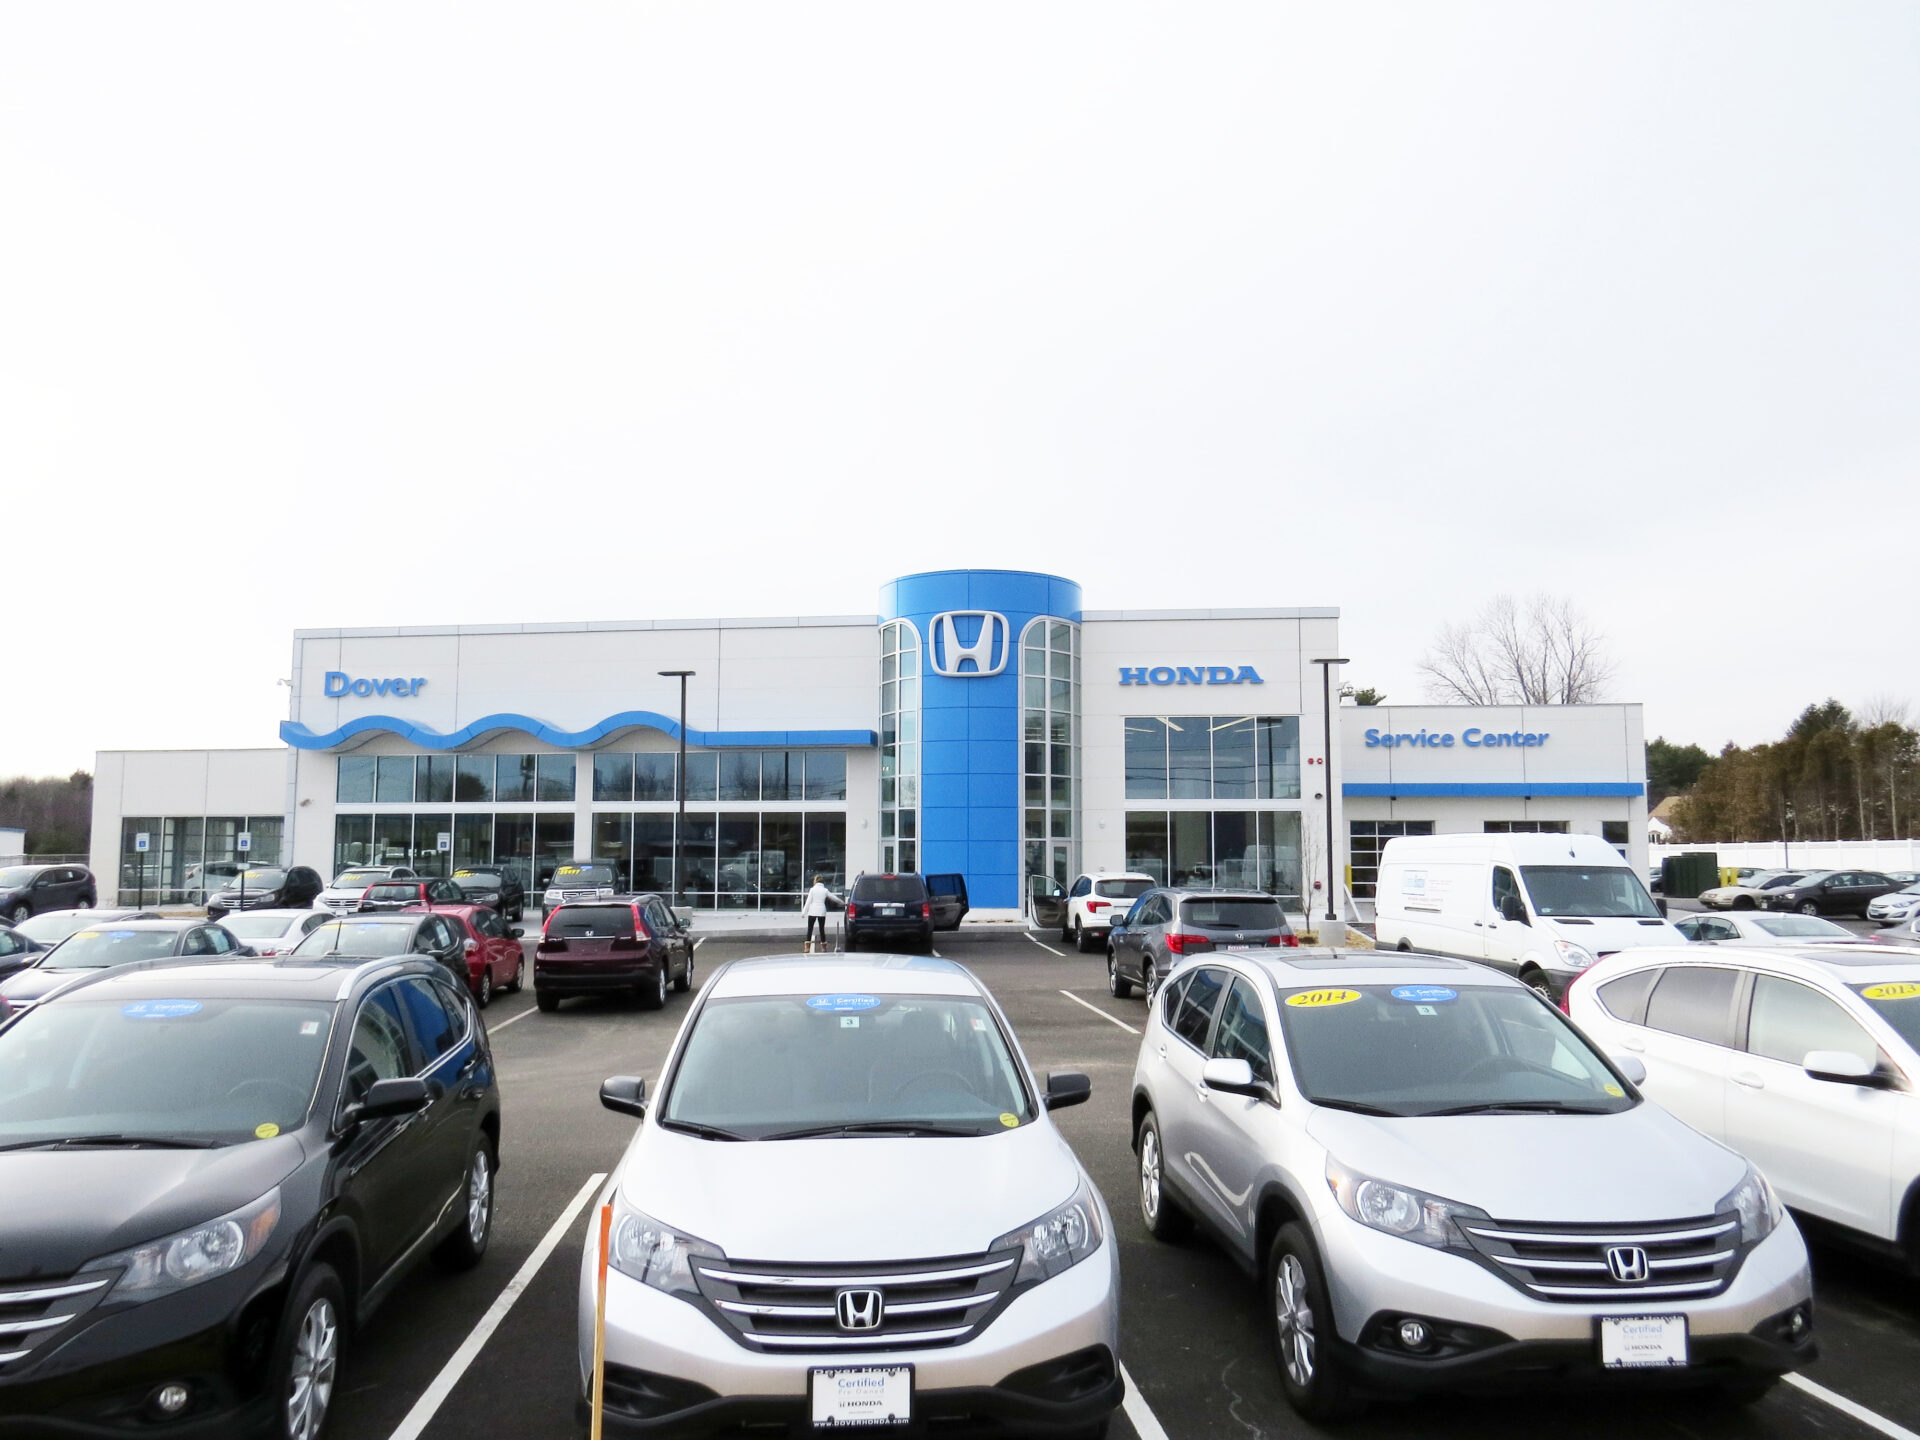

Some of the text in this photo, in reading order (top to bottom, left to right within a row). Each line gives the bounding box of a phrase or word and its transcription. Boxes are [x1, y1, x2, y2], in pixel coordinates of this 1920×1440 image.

[1118, 665, 1264, 685] HONDA
[324, 671, 427, 697] Dover
[1364, 727, 1551, 748] Service Center
[1298, 991, 1347, 1005] 2014
[1622, 1324, 1663, 1334] Certified
[838, 1377, 885, 1388] Certified
